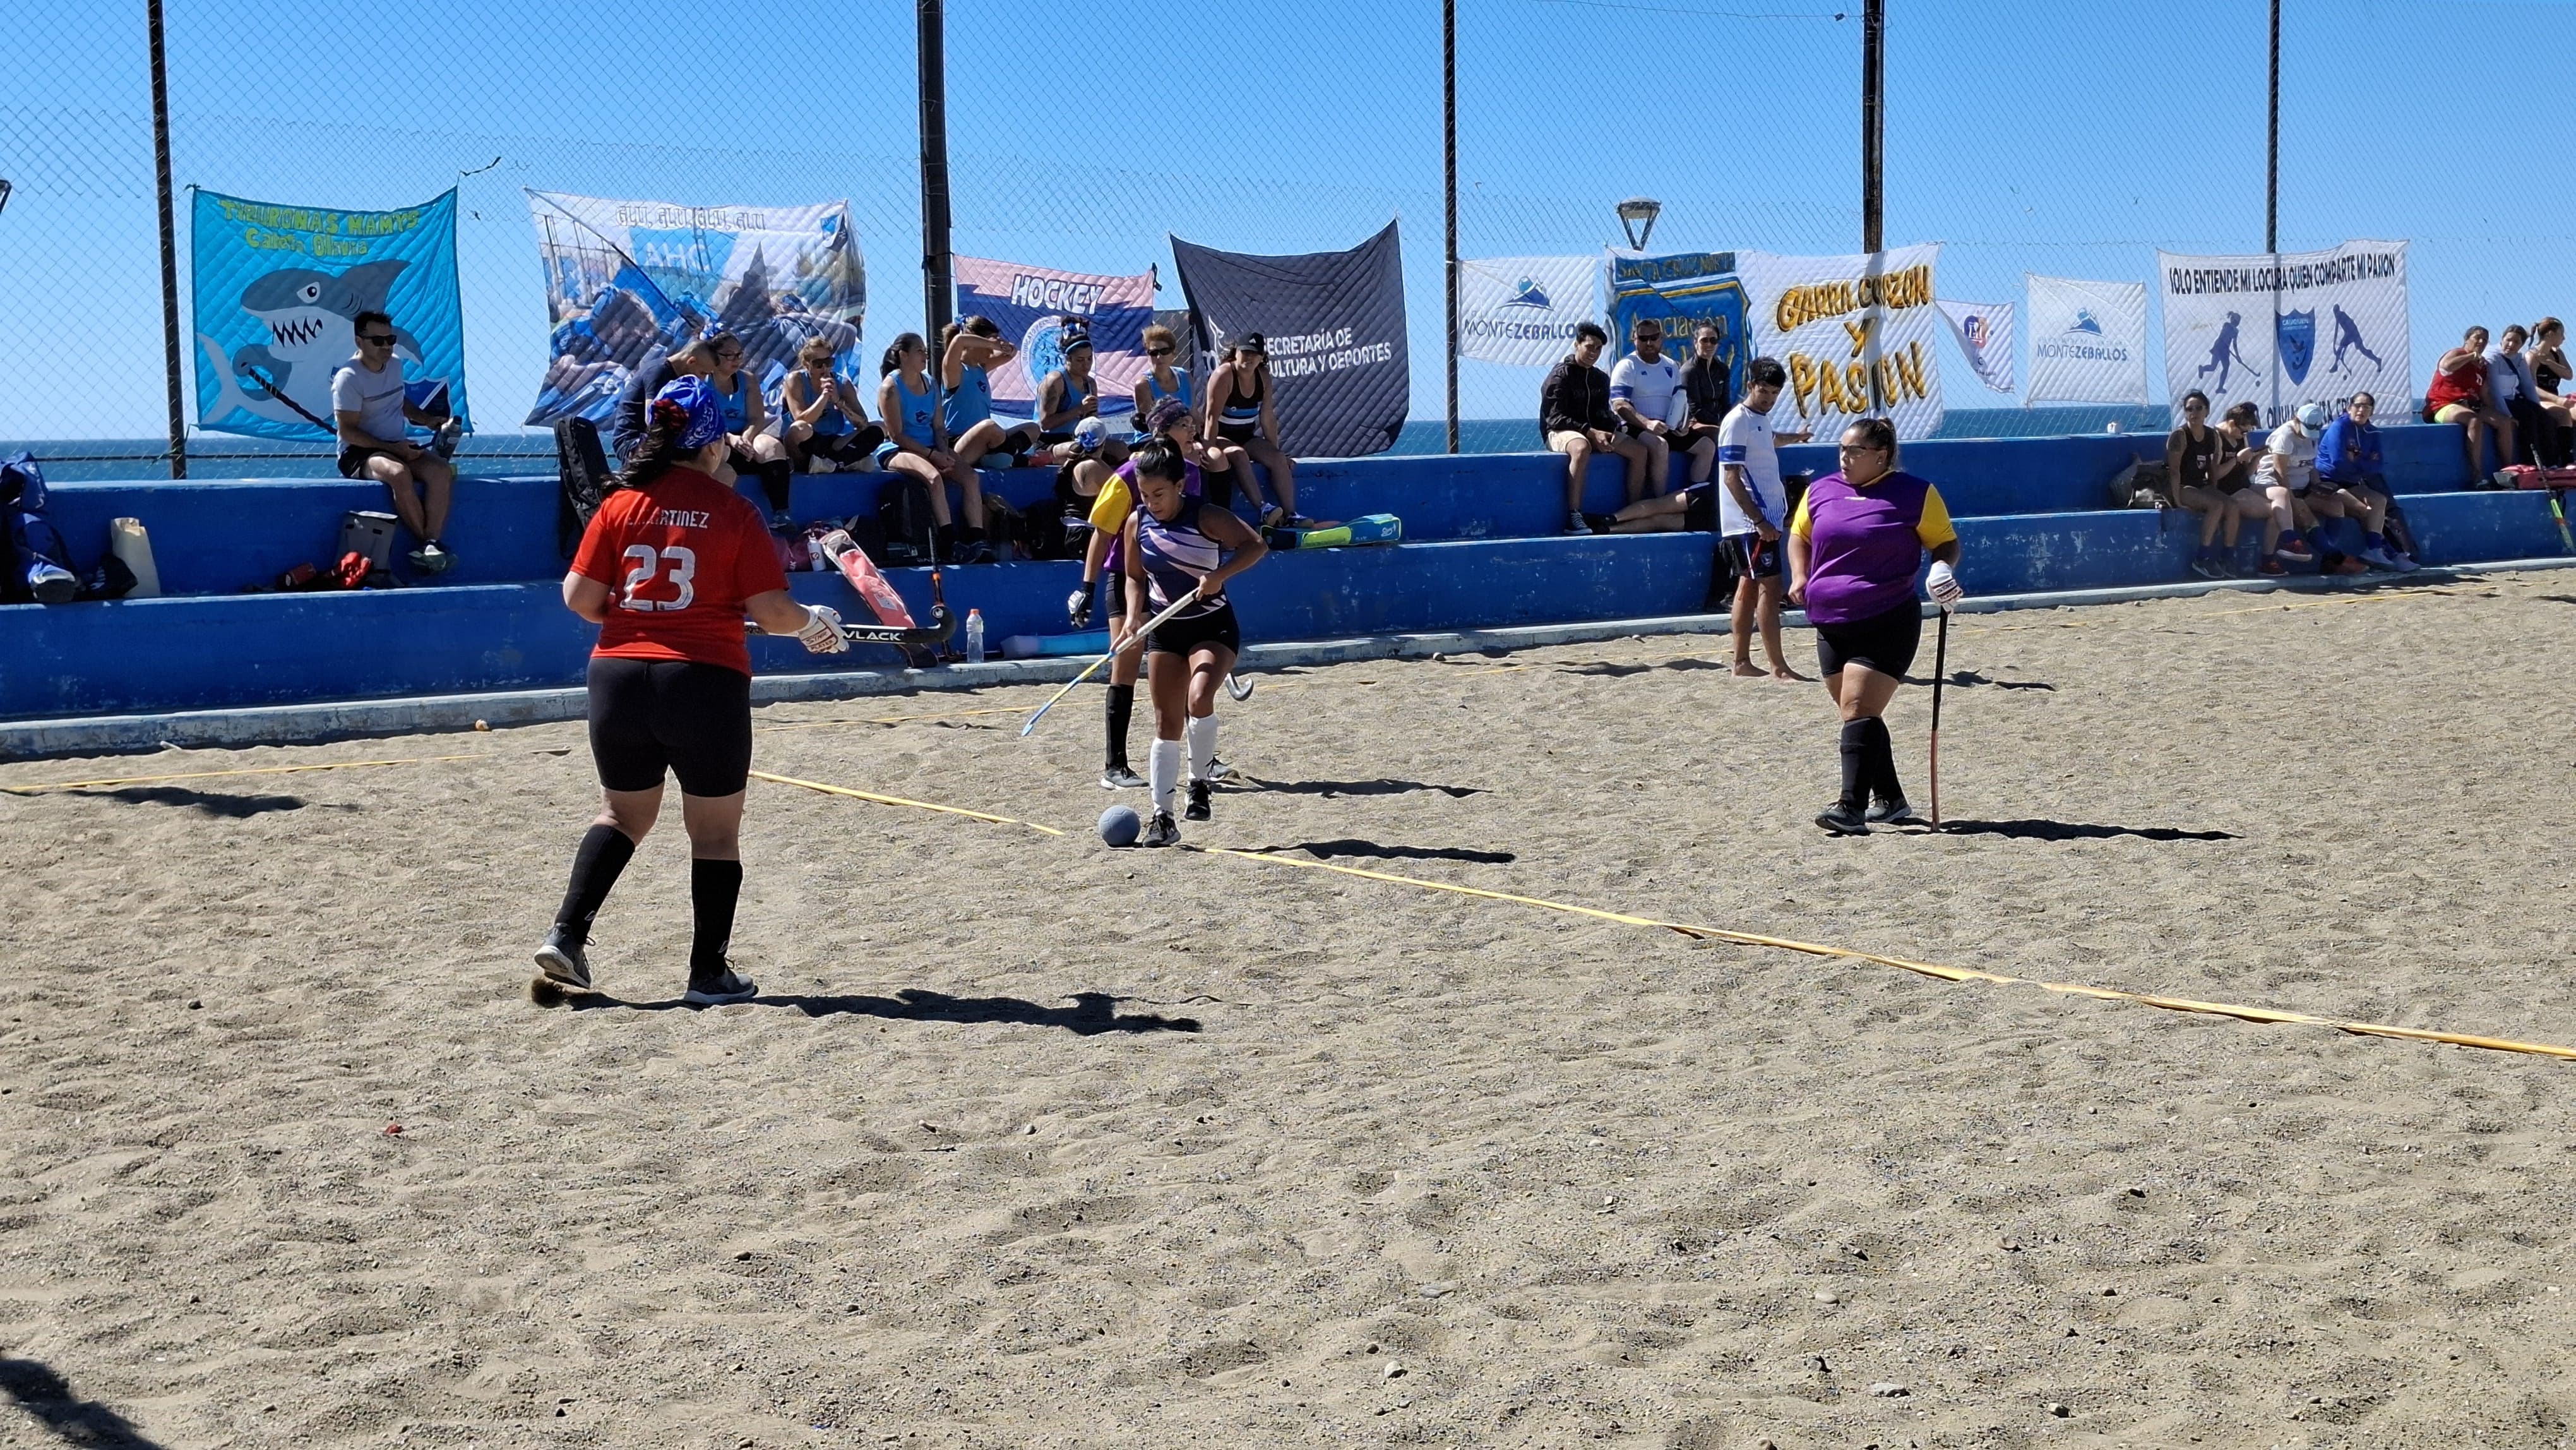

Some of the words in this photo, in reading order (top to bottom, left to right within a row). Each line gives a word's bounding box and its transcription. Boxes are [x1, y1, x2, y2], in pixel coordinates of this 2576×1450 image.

[348, 210, 420, 236] MAMYS
[313, 234, 368, 256] Olivia
[645, 242, 711, 272] AHC
[2193, 268, 2239, 294] ENTIENDE
[2241, 268, 2251, 292] MI
[2253, 267, 2288, 292] LOCURA
[2289, 264, 2313, 294] QUIEN
[2314, 255, 2355, 287] COMPARTE
[2357, 253, 2366, 279] MI
[1010, 273, 1105, 315] HOCKEY
[1335, 327, 1352, 347] DE
[1464, 319, 1577, 340] MONTEZEBALLO
[1844, 317, 1878, 357] Y
[1268, 356, 1318, 378] ULTURA
[1318, 354, 1327, 372] Y
[1328, 342, 1392, 371] DEPORTES
[2037, 343, 2128, 361] MONTEZEBALLOS
[619, 544, 696, 611] 23
